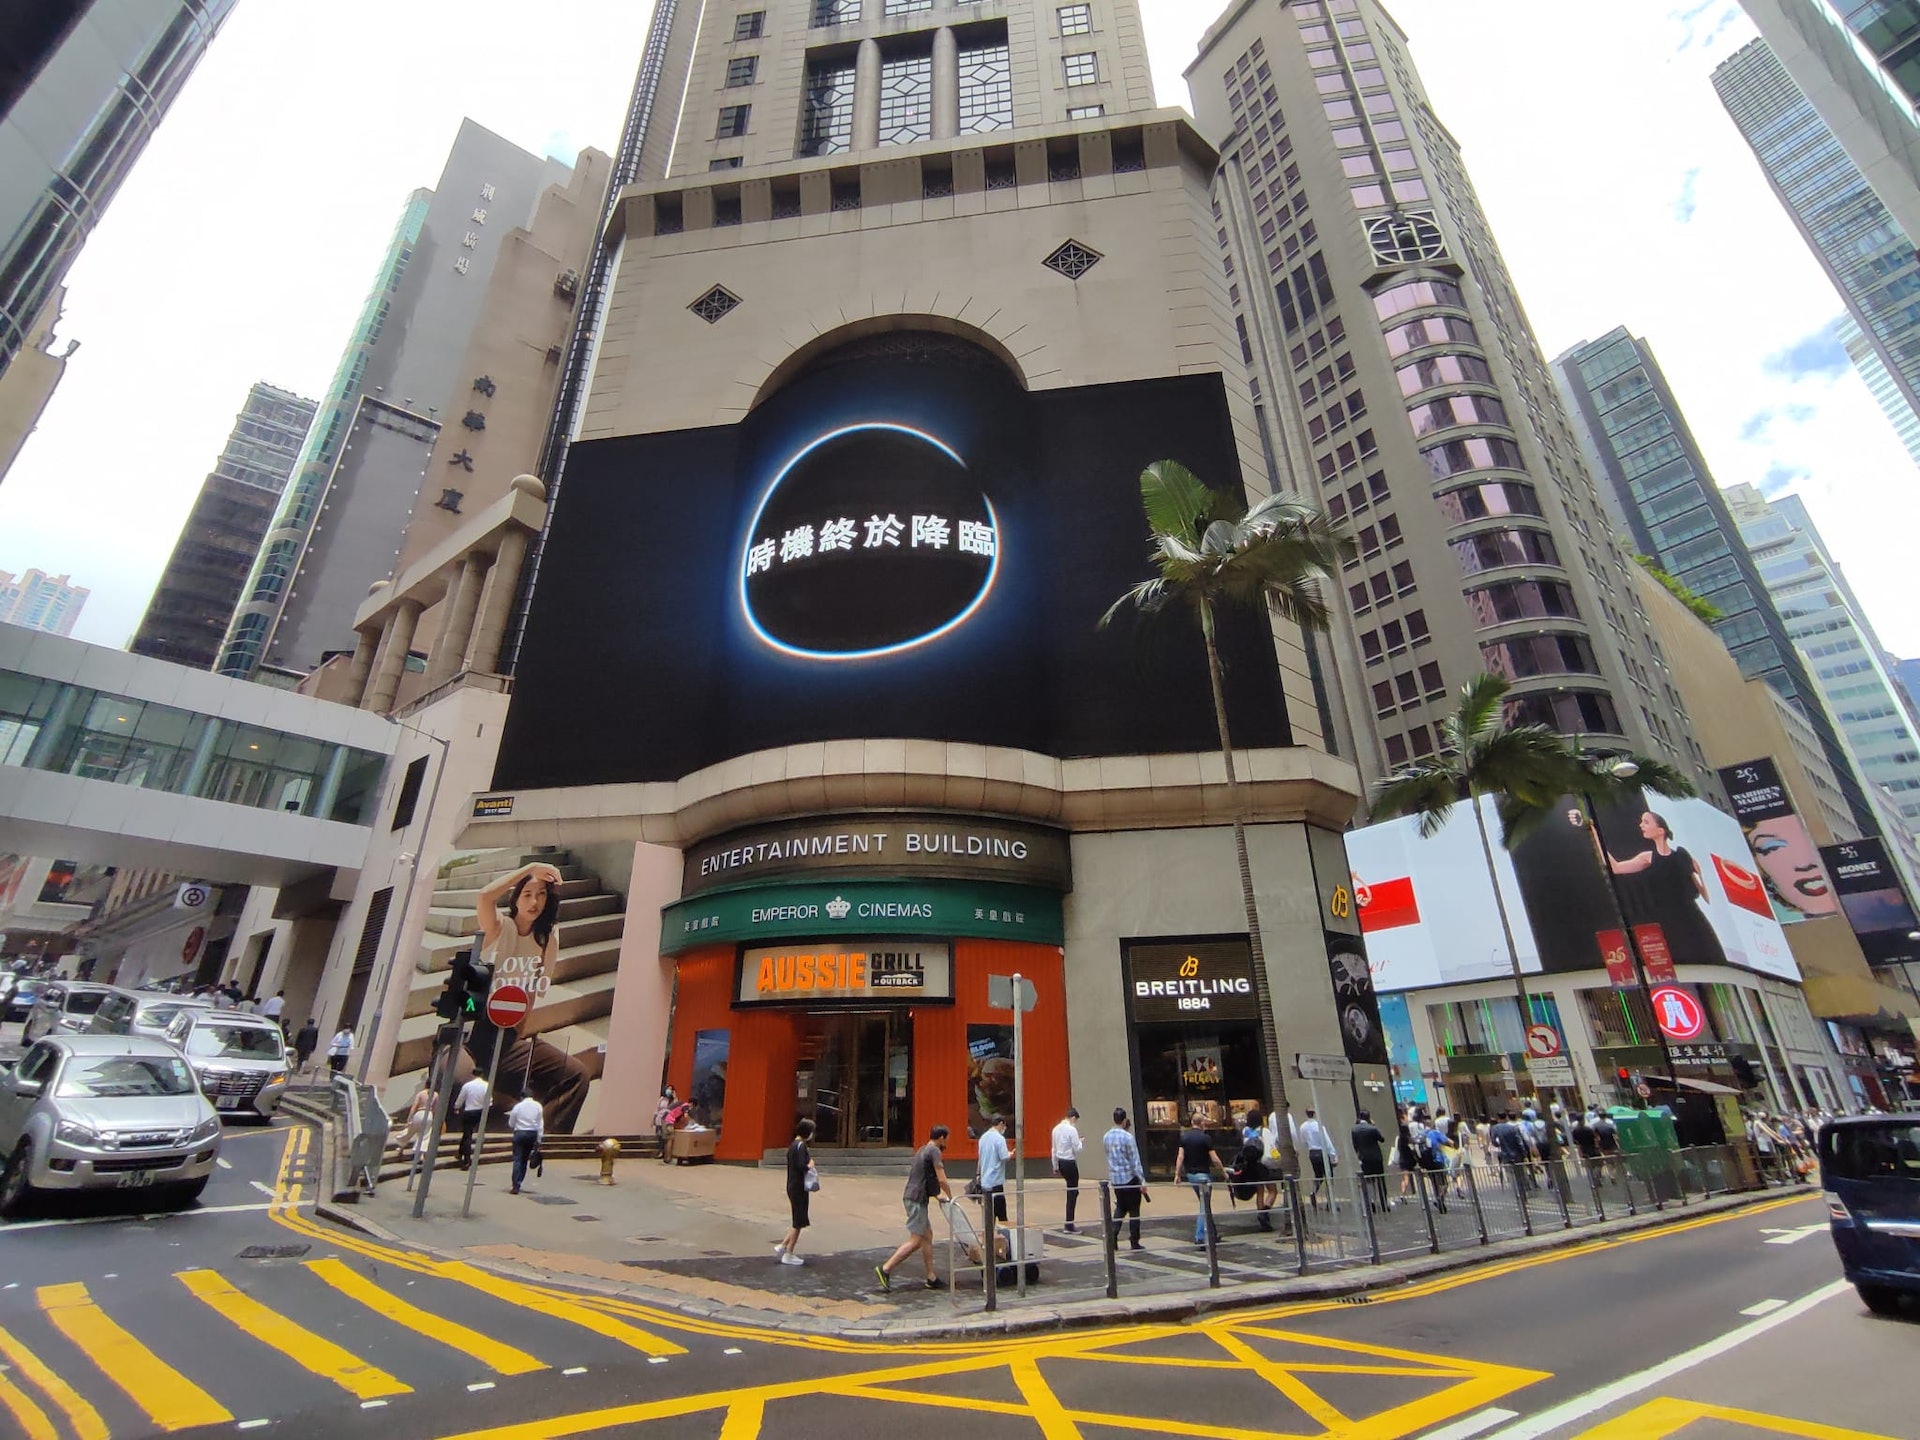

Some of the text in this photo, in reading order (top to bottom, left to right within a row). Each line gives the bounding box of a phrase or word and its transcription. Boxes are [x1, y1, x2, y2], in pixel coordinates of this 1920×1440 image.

[746, 513, 996, 578] 時機終於降臨
[476, 799, 513, 809] Avanti
[701, 833, 1028, 877] ENTERTAINMENT BUILDING
[1836, 861, 1877, 874] MONET
[751, 902, 933, 924] EMPEROR CINEMAS
[756, 953, 925, 992] AUSSIE GRILL
[880, 977, 919, 986] OUTBACK
[1135, 978, 1251, 997] BREITLING
[1178, 997, 1211, 1010] 1884
